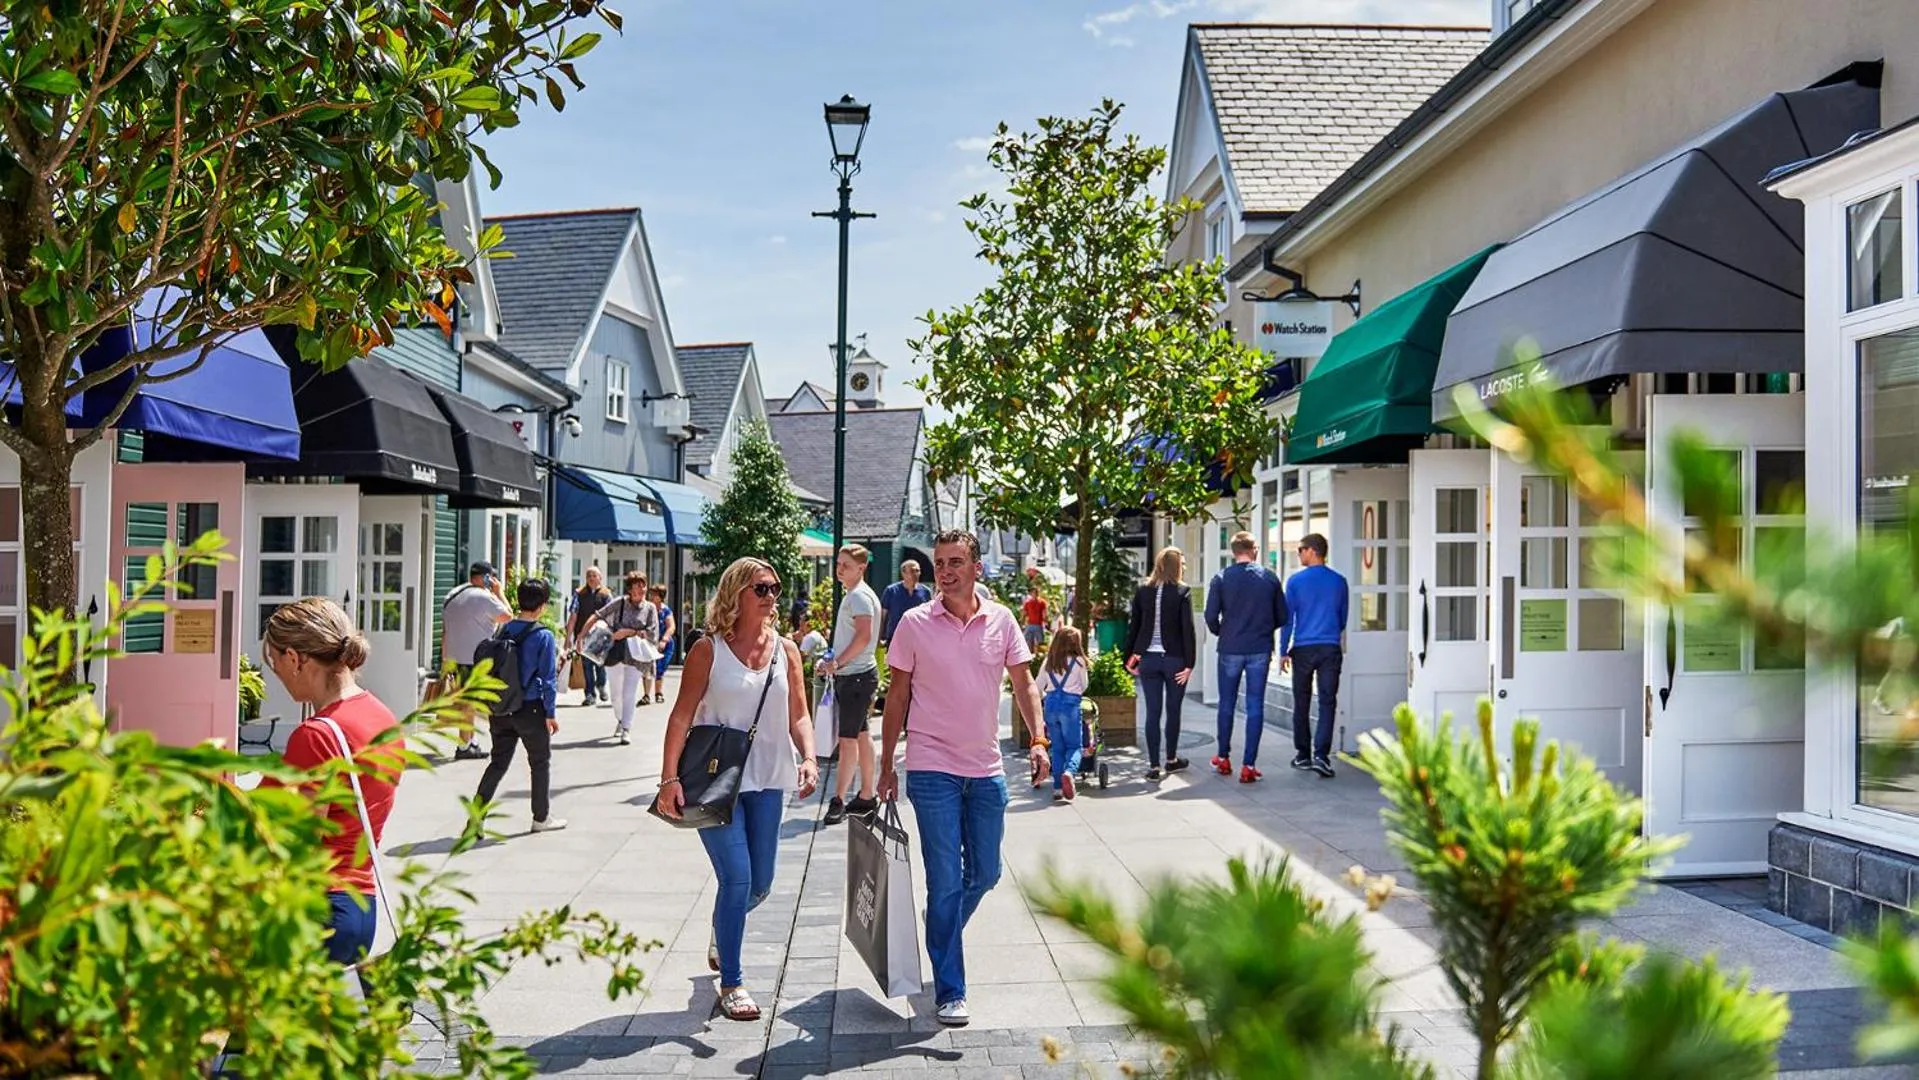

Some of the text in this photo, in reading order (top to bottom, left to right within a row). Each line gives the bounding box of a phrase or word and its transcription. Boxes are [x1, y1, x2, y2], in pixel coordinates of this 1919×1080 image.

[1274, 322, 1327, 334] Watch Station
[1481, 373, 1524, 400] LACOSTE
